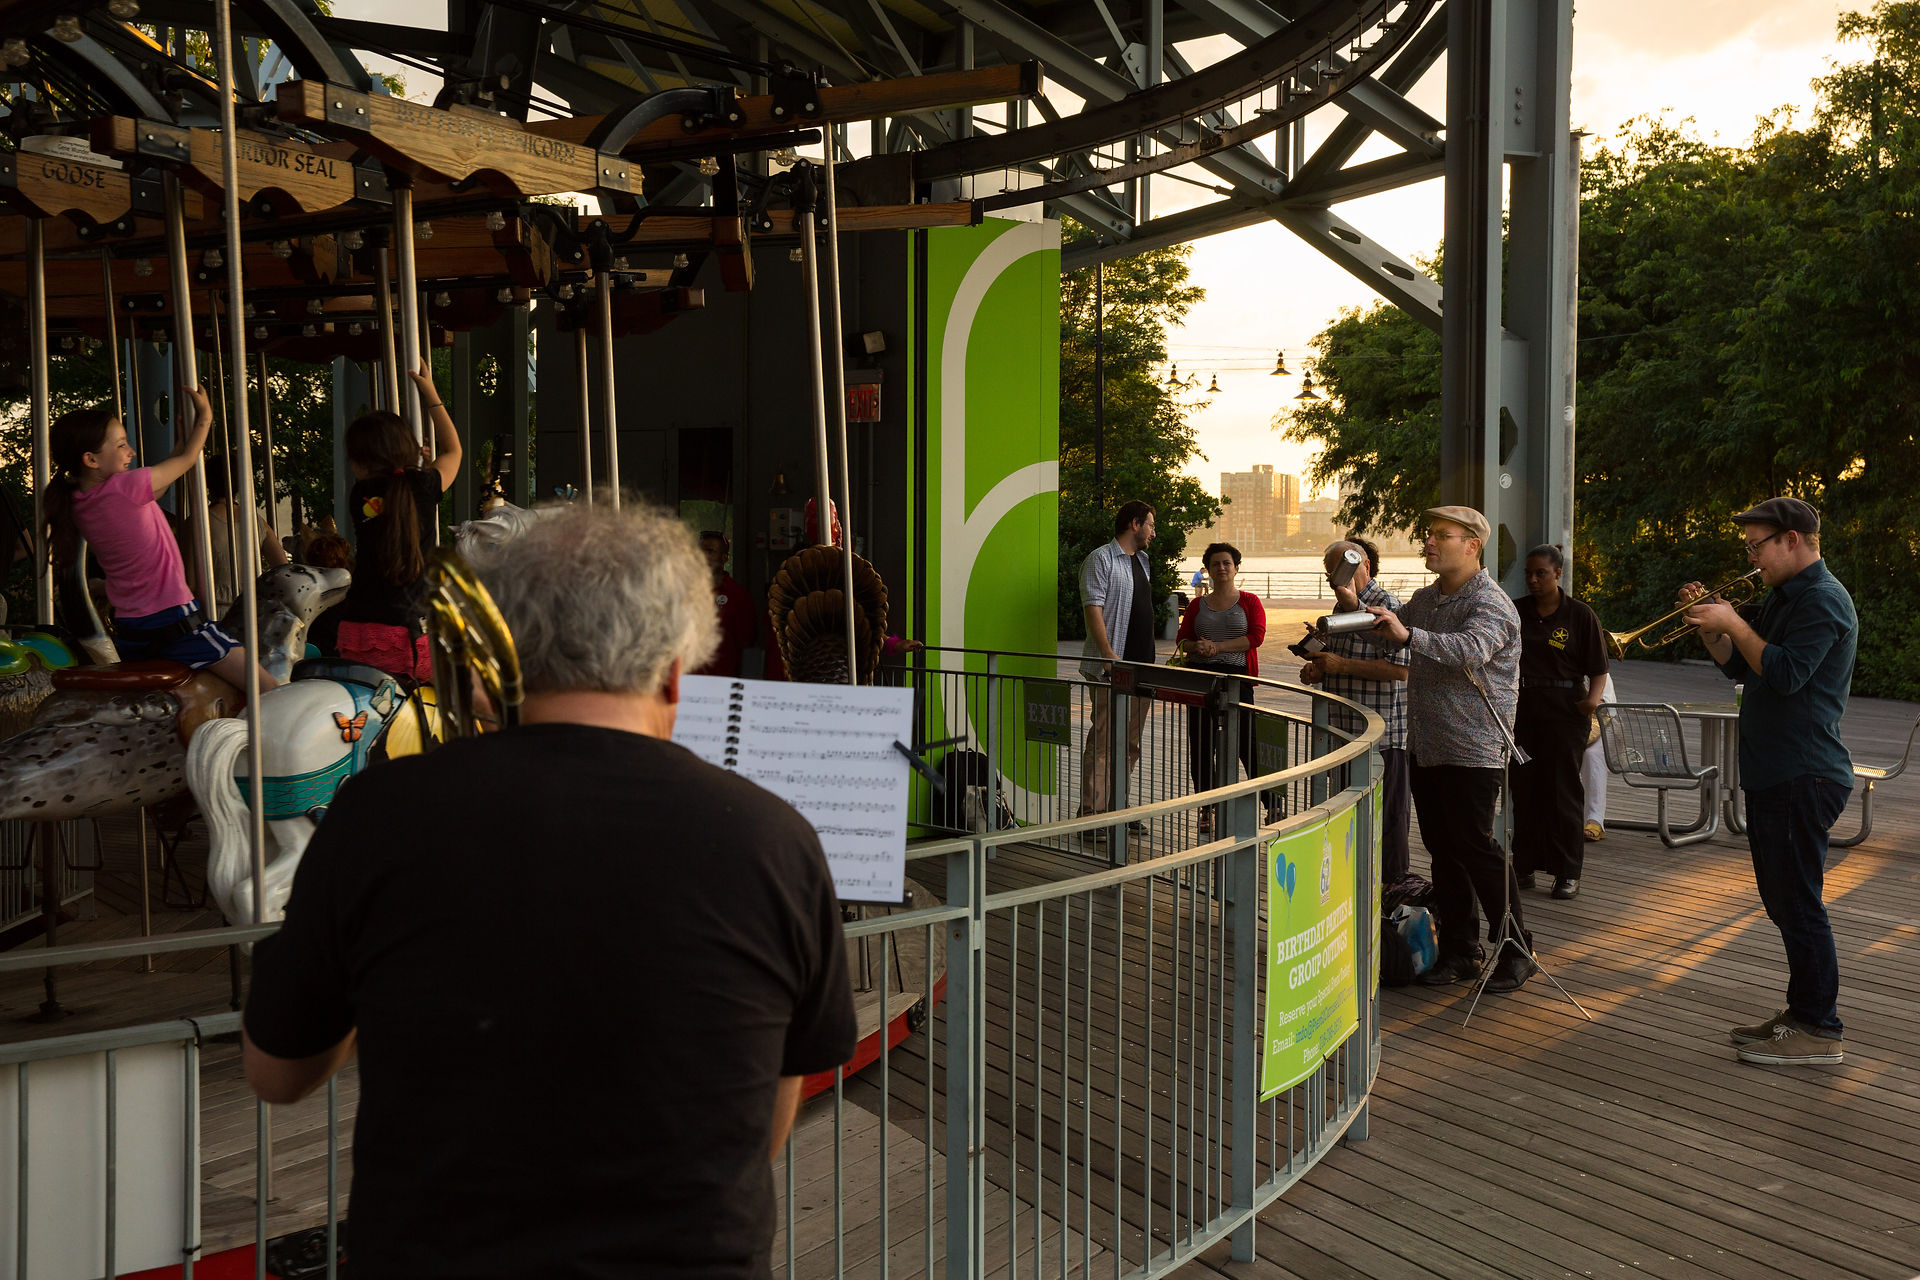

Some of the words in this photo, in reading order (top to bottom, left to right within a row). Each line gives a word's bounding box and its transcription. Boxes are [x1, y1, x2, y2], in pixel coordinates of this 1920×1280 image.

[212, 135, 289, 169] HRBOR
[294, 153, 337, 179] SEAL
[502, 128, 577, 164] UNICORN
[42, 160, 105, 189] GOOSE
[849, 389, 874, 419] EXIT
[1113, 668, 1132, 688] EXIT
[1026, 702, 1068, 728] EXIT
[1258, 741, 1286, 771] EXIT
[1276, 919, 1326, 965] BIRTHDAY
[1325, 901, 1348, 938] PARTIES
[1288, 952, 1322, 990] GROUP
[1322, 928, 1348, 969] OUTINGS
[1279, 1003, 1306, 1027] Reserve
[1306, 994, 1318, 1016] your
[1272, 1031, 1295, 1056] Email:
